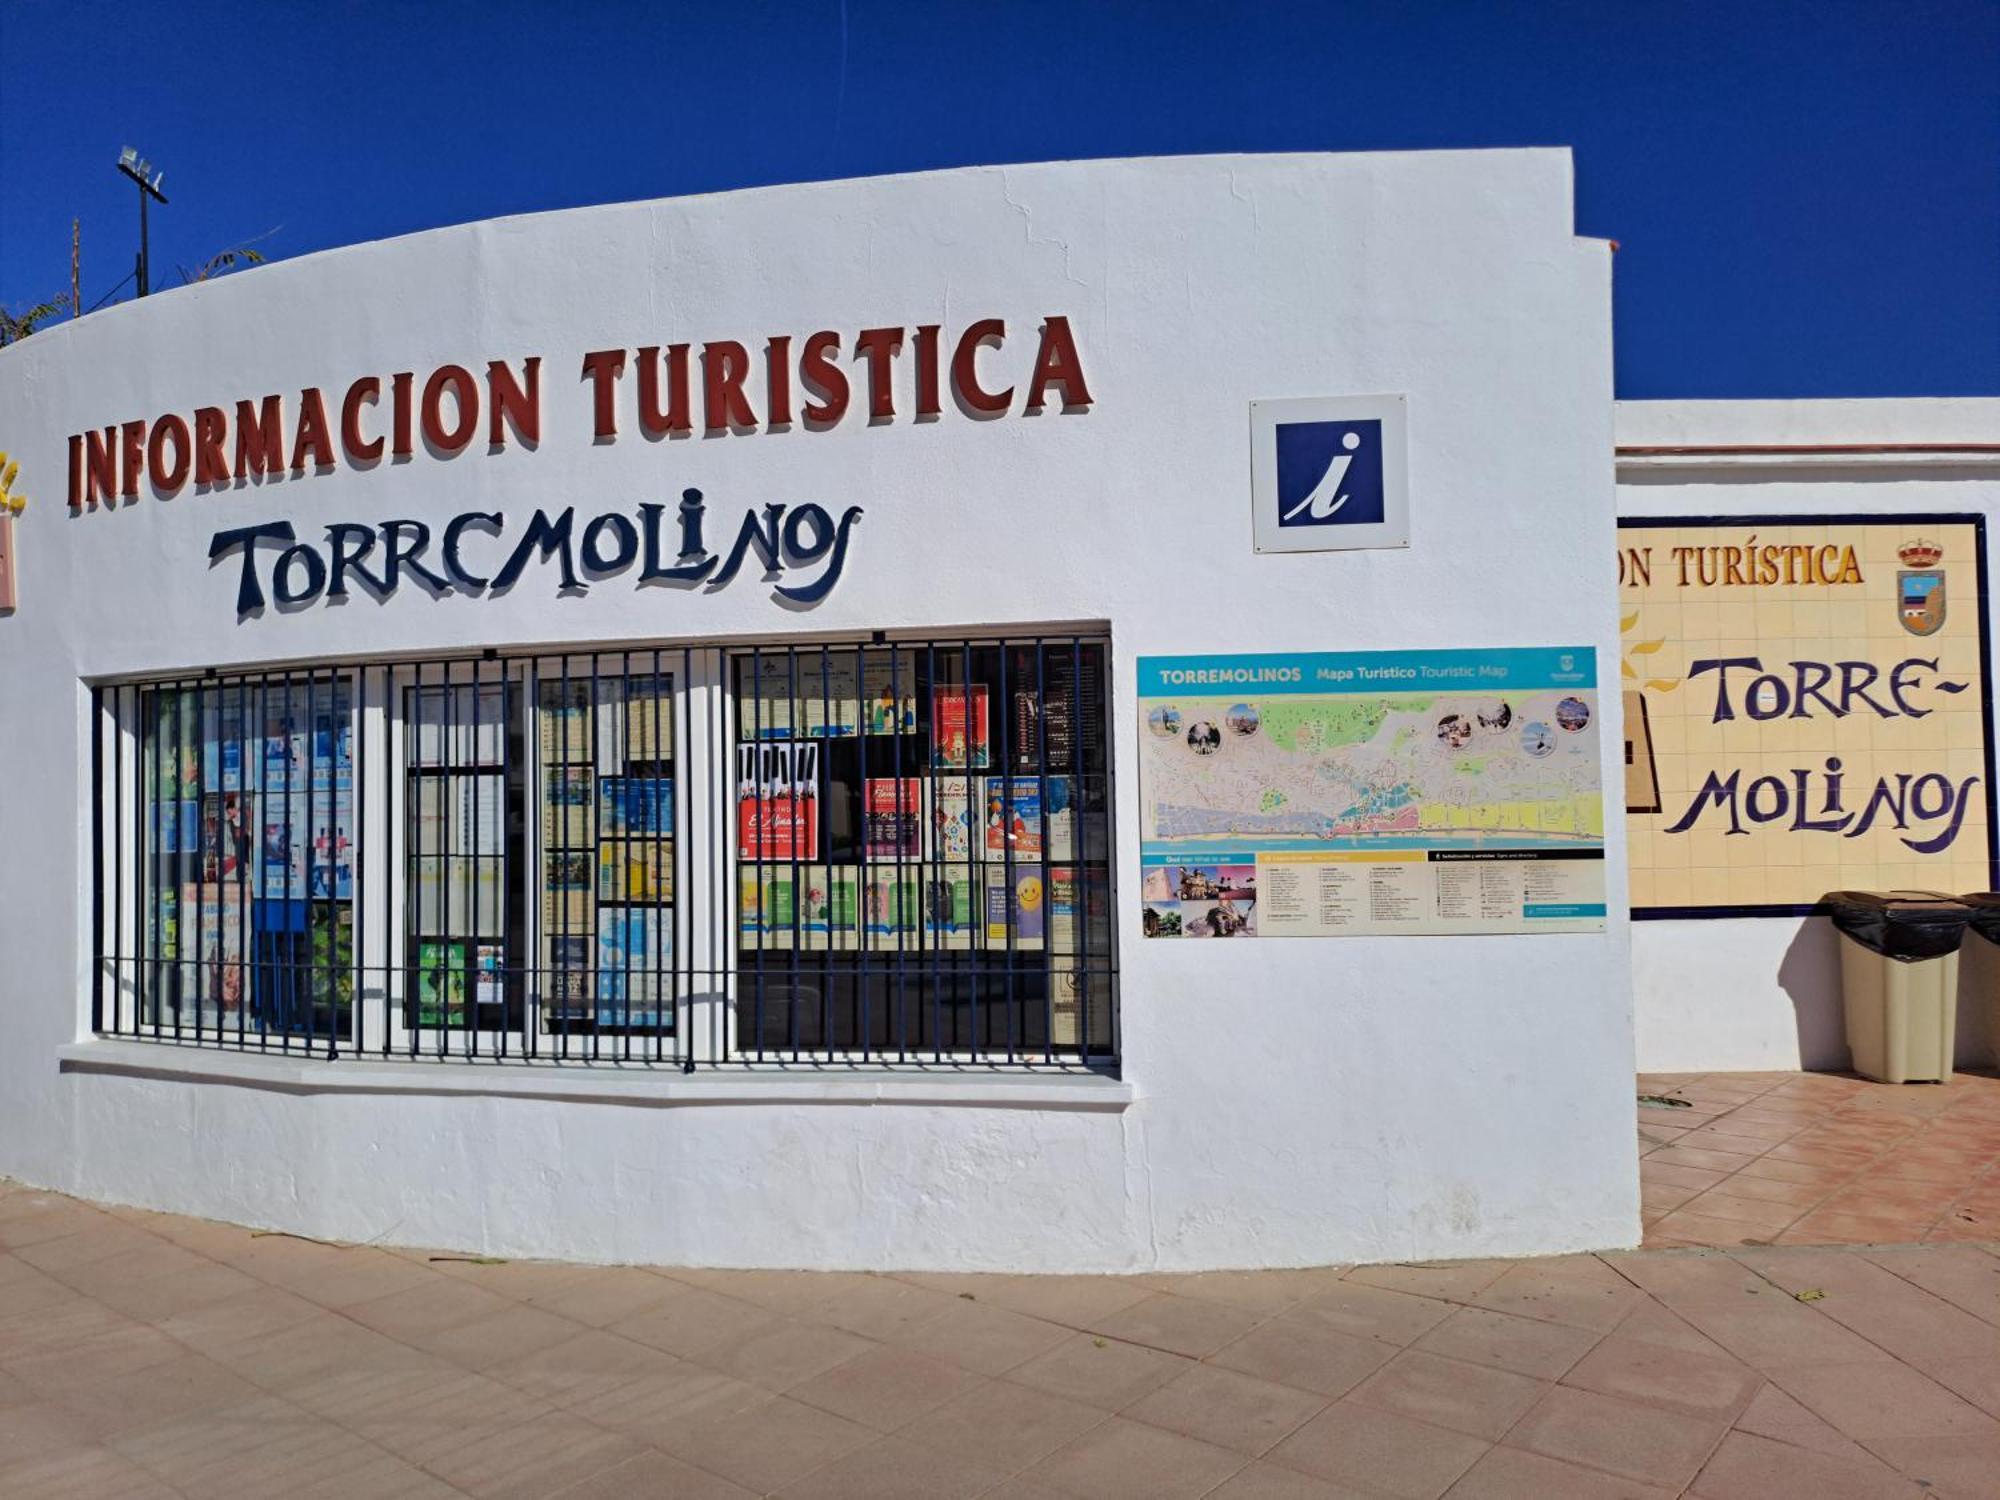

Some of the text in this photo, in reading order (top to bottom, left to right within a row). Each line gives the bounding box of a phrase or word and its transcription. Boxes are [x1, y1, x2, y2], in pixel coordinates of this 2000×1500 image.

[68, 315, 1095, 508] INFORMACION TURISTICA
[1671, 534, 1865, 588] TURÍSTICA
[1160, 667, 1302, 684] TORREMOLINOS
[1317, 668, 1354, 681] Mapa
[1419, 664, 1475, 678] Touristic
[1478, 664, 1509, 680] Map
